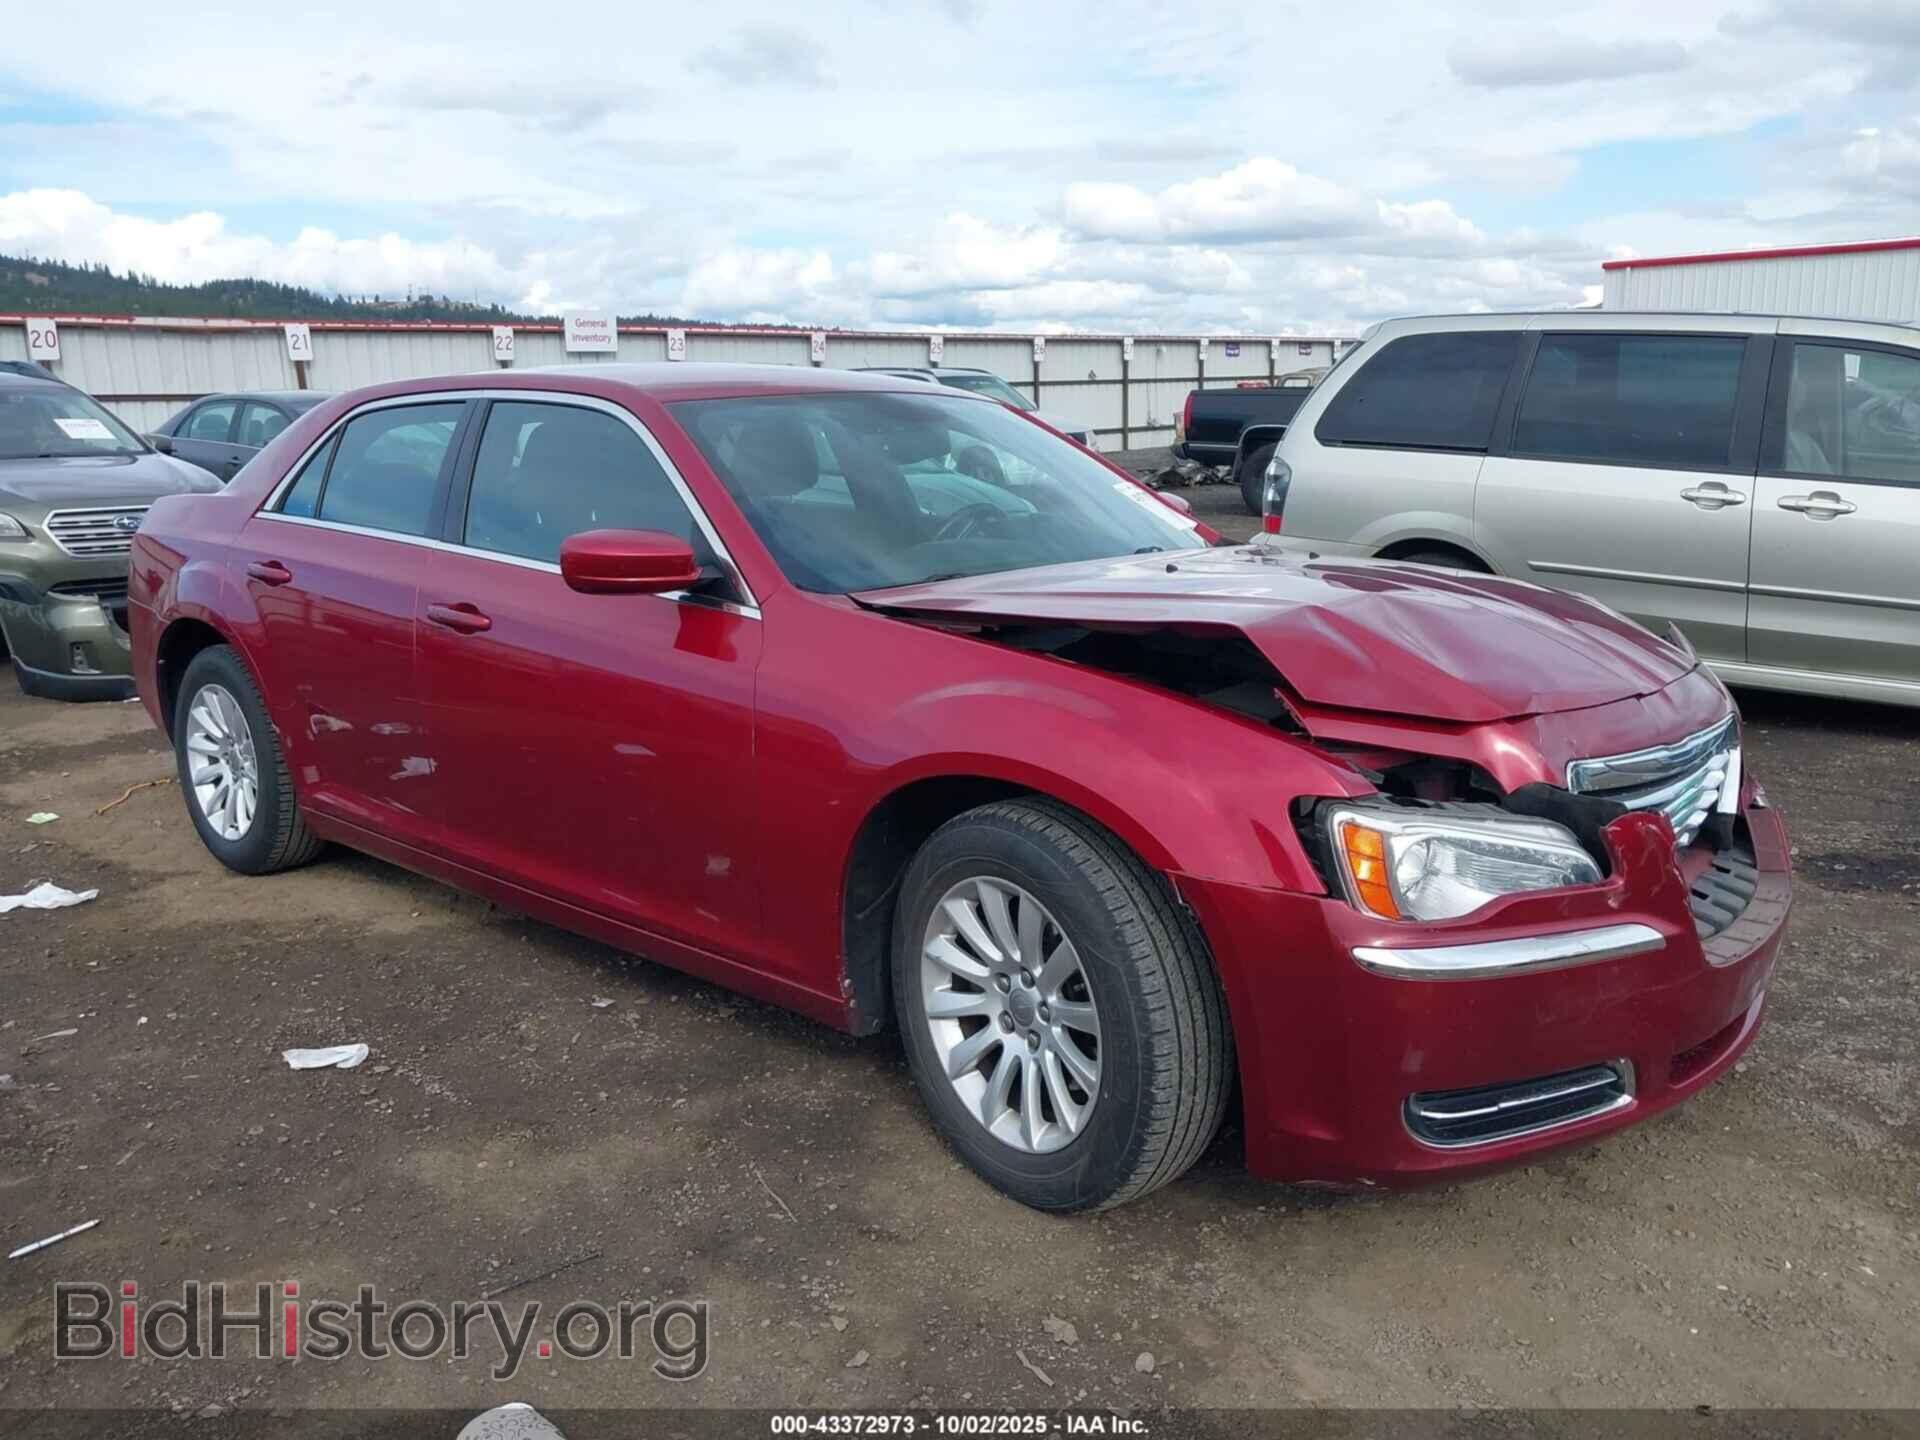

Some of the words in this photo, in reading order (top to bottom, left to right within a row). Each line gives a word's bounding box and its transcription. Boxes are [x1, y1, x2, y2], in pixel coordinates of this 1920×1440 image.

[575, 318, 608, 329] General
[30, 330, 57, 348] 20
[290, 334, 308, 350] 21
[495, 335, 513, 351] 22
[572, 333, 612, 344] Inventory
[670, 337, 684, 352] 23
[814, 340, 825, 353] 24
[931, 342, 942, 354] 25
